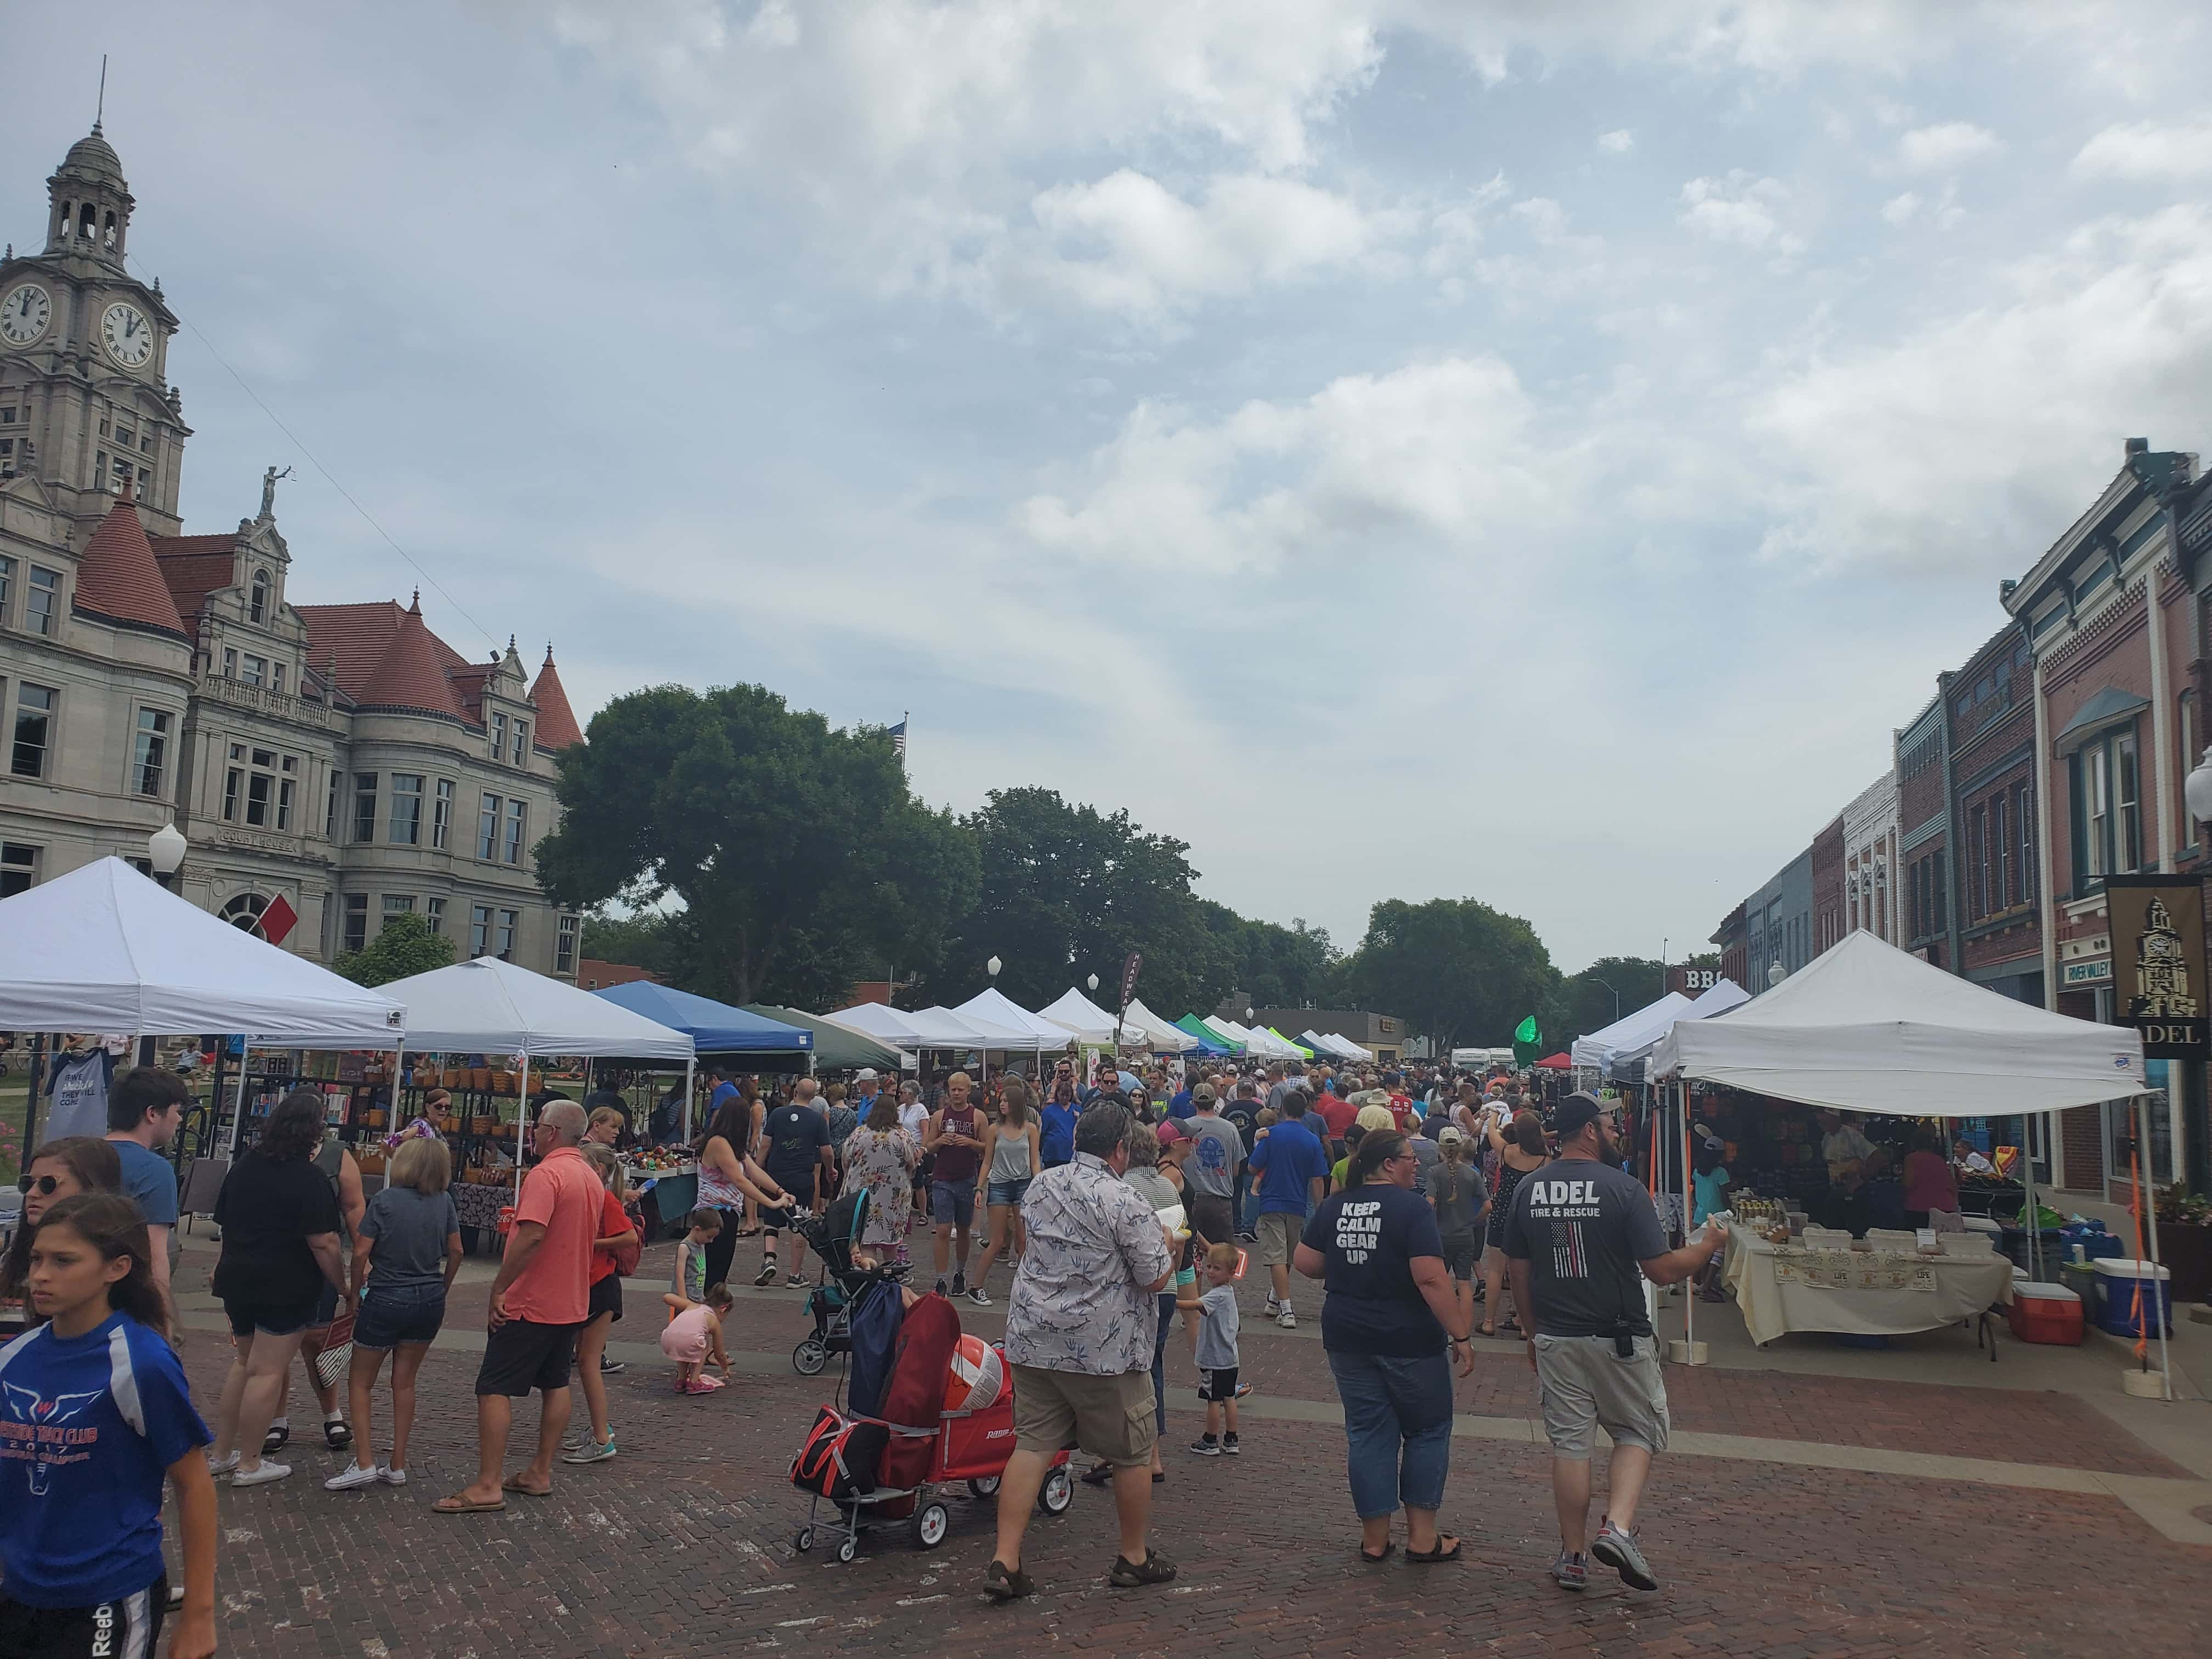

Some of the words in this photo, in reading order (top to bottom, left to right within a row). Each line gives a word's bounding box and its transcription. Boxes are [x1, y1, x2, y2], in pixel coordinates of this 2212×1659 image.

[223, 831, 257, 844] COURT
[259, 836, 294, 850] HOUSE
[2069, 965, 2086, 981] RIVER
[2086, 961, 2109, 978] VALLEY
[1121, 953, 1139, 1012] HEADWEAR
[2141, 1024, 2201, 1044] DEL
[60, 1098, 80, 1107] COME
[1530, 1181, 1600, 1205] ADEL
[1341, 1201, 1381, 1216] KEEP
[1530, 1208, 1550, 1218] FIRE
[1552, 1207, 1561, 1217] &
[1563, 1207, 1600, 1217] RESCUE
[1336, 1217, 1381, 1233] CALM
[1336, 1233, 1378, 1250] GEAR
[1346, 1250, 1368, 1265] UP
[65, 1427, 98, 1444] CLUB
[92, 1602, 113, 1657] Reeb
